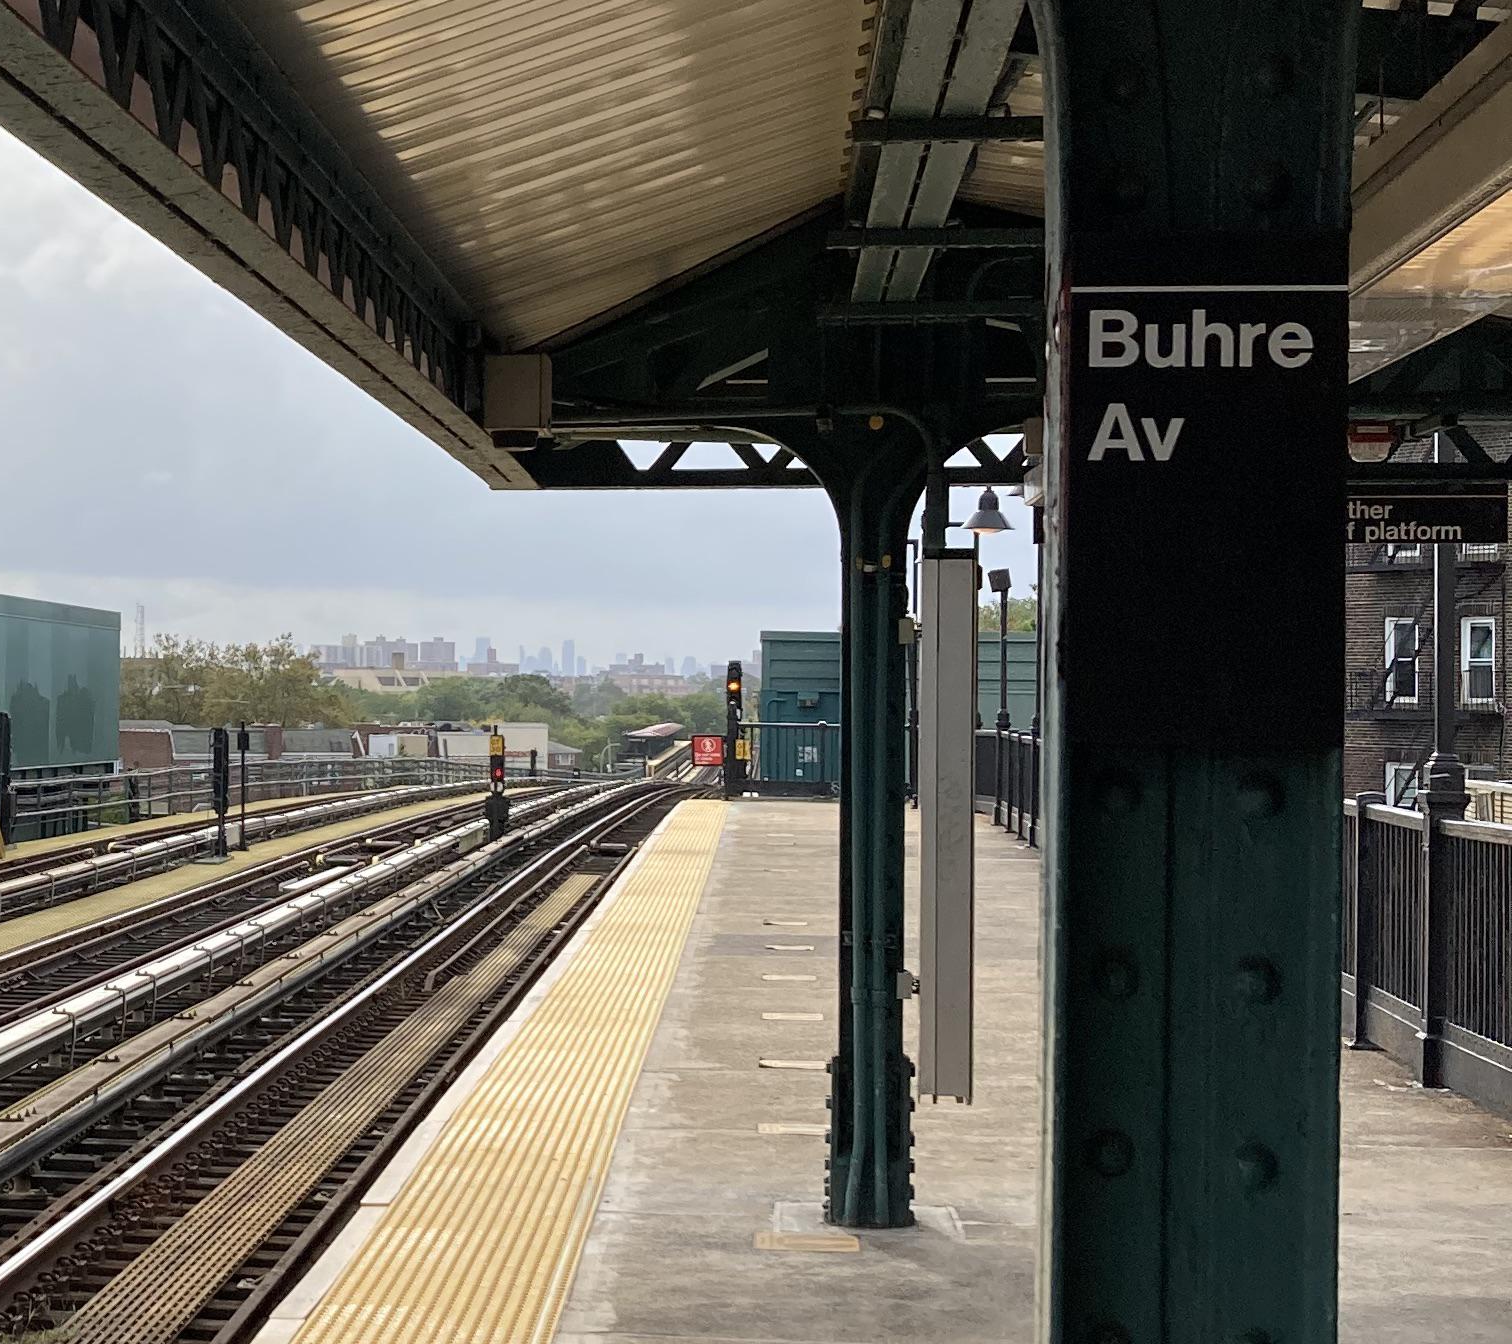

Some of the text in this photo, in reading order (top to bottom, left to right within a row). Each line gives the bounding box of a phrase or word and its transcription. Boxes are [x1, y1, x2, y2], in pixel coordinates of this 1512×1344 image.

[1088, 308, 1314, 369] Buhre
[1087, 402, 1185, 462] Av
[1347, 500, 1393, 520] ther
[1365, 520, 1462, 544] platform
